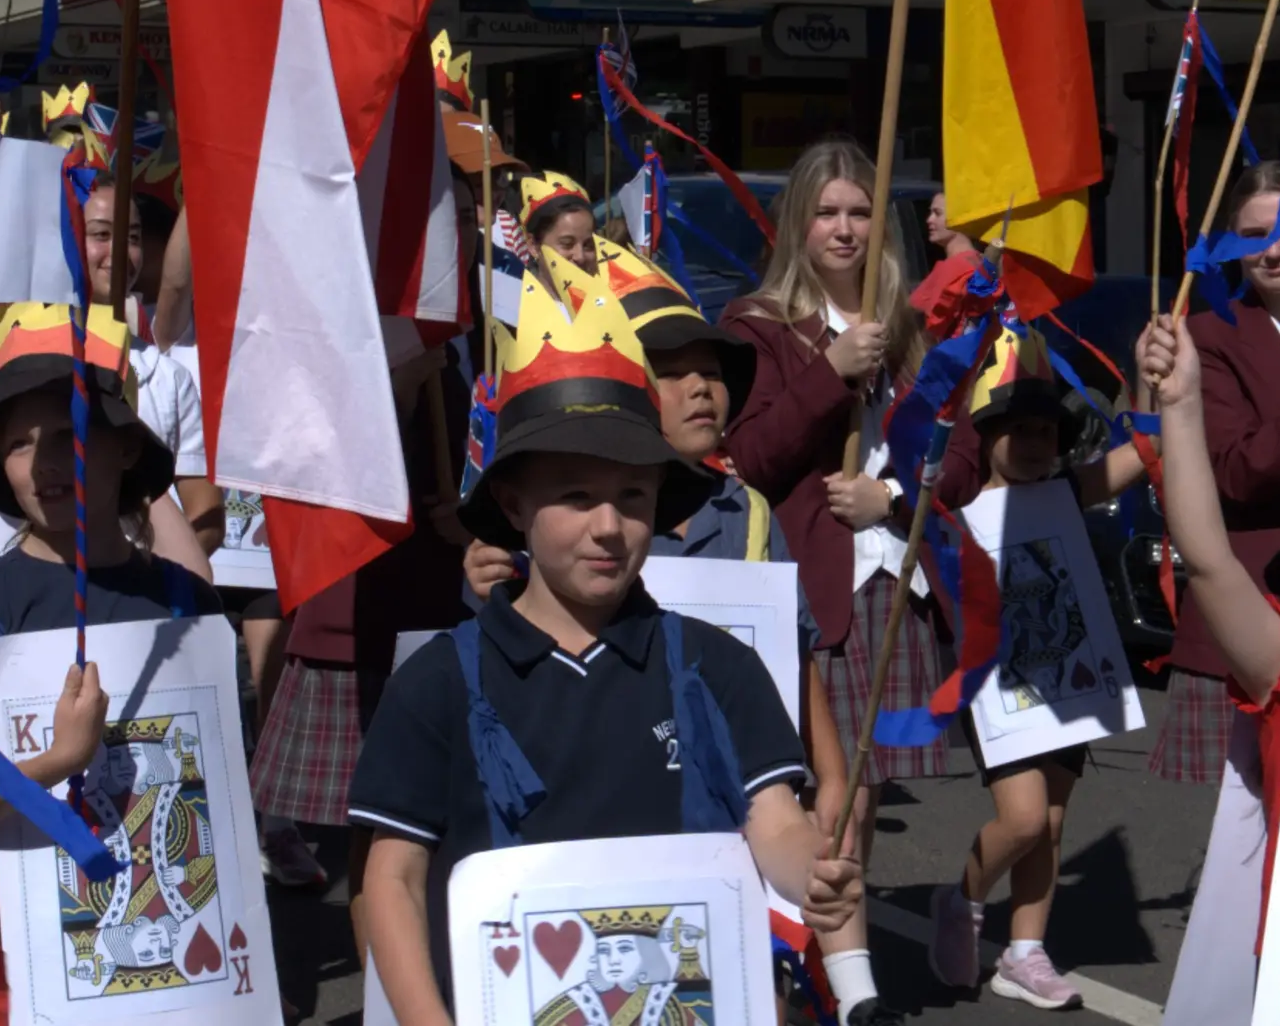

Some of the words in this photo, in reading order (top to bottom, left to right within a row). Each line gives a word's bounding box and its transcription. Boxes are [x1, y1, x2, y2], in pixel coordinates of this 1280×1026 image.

[489, 21, 543, 36] CALARE
[547, 22, 579, 36] HAIR
[787, 25, 850, 43] NRMA
[11, 713, 42, 754] K
[229, 955, 254, 996] K
